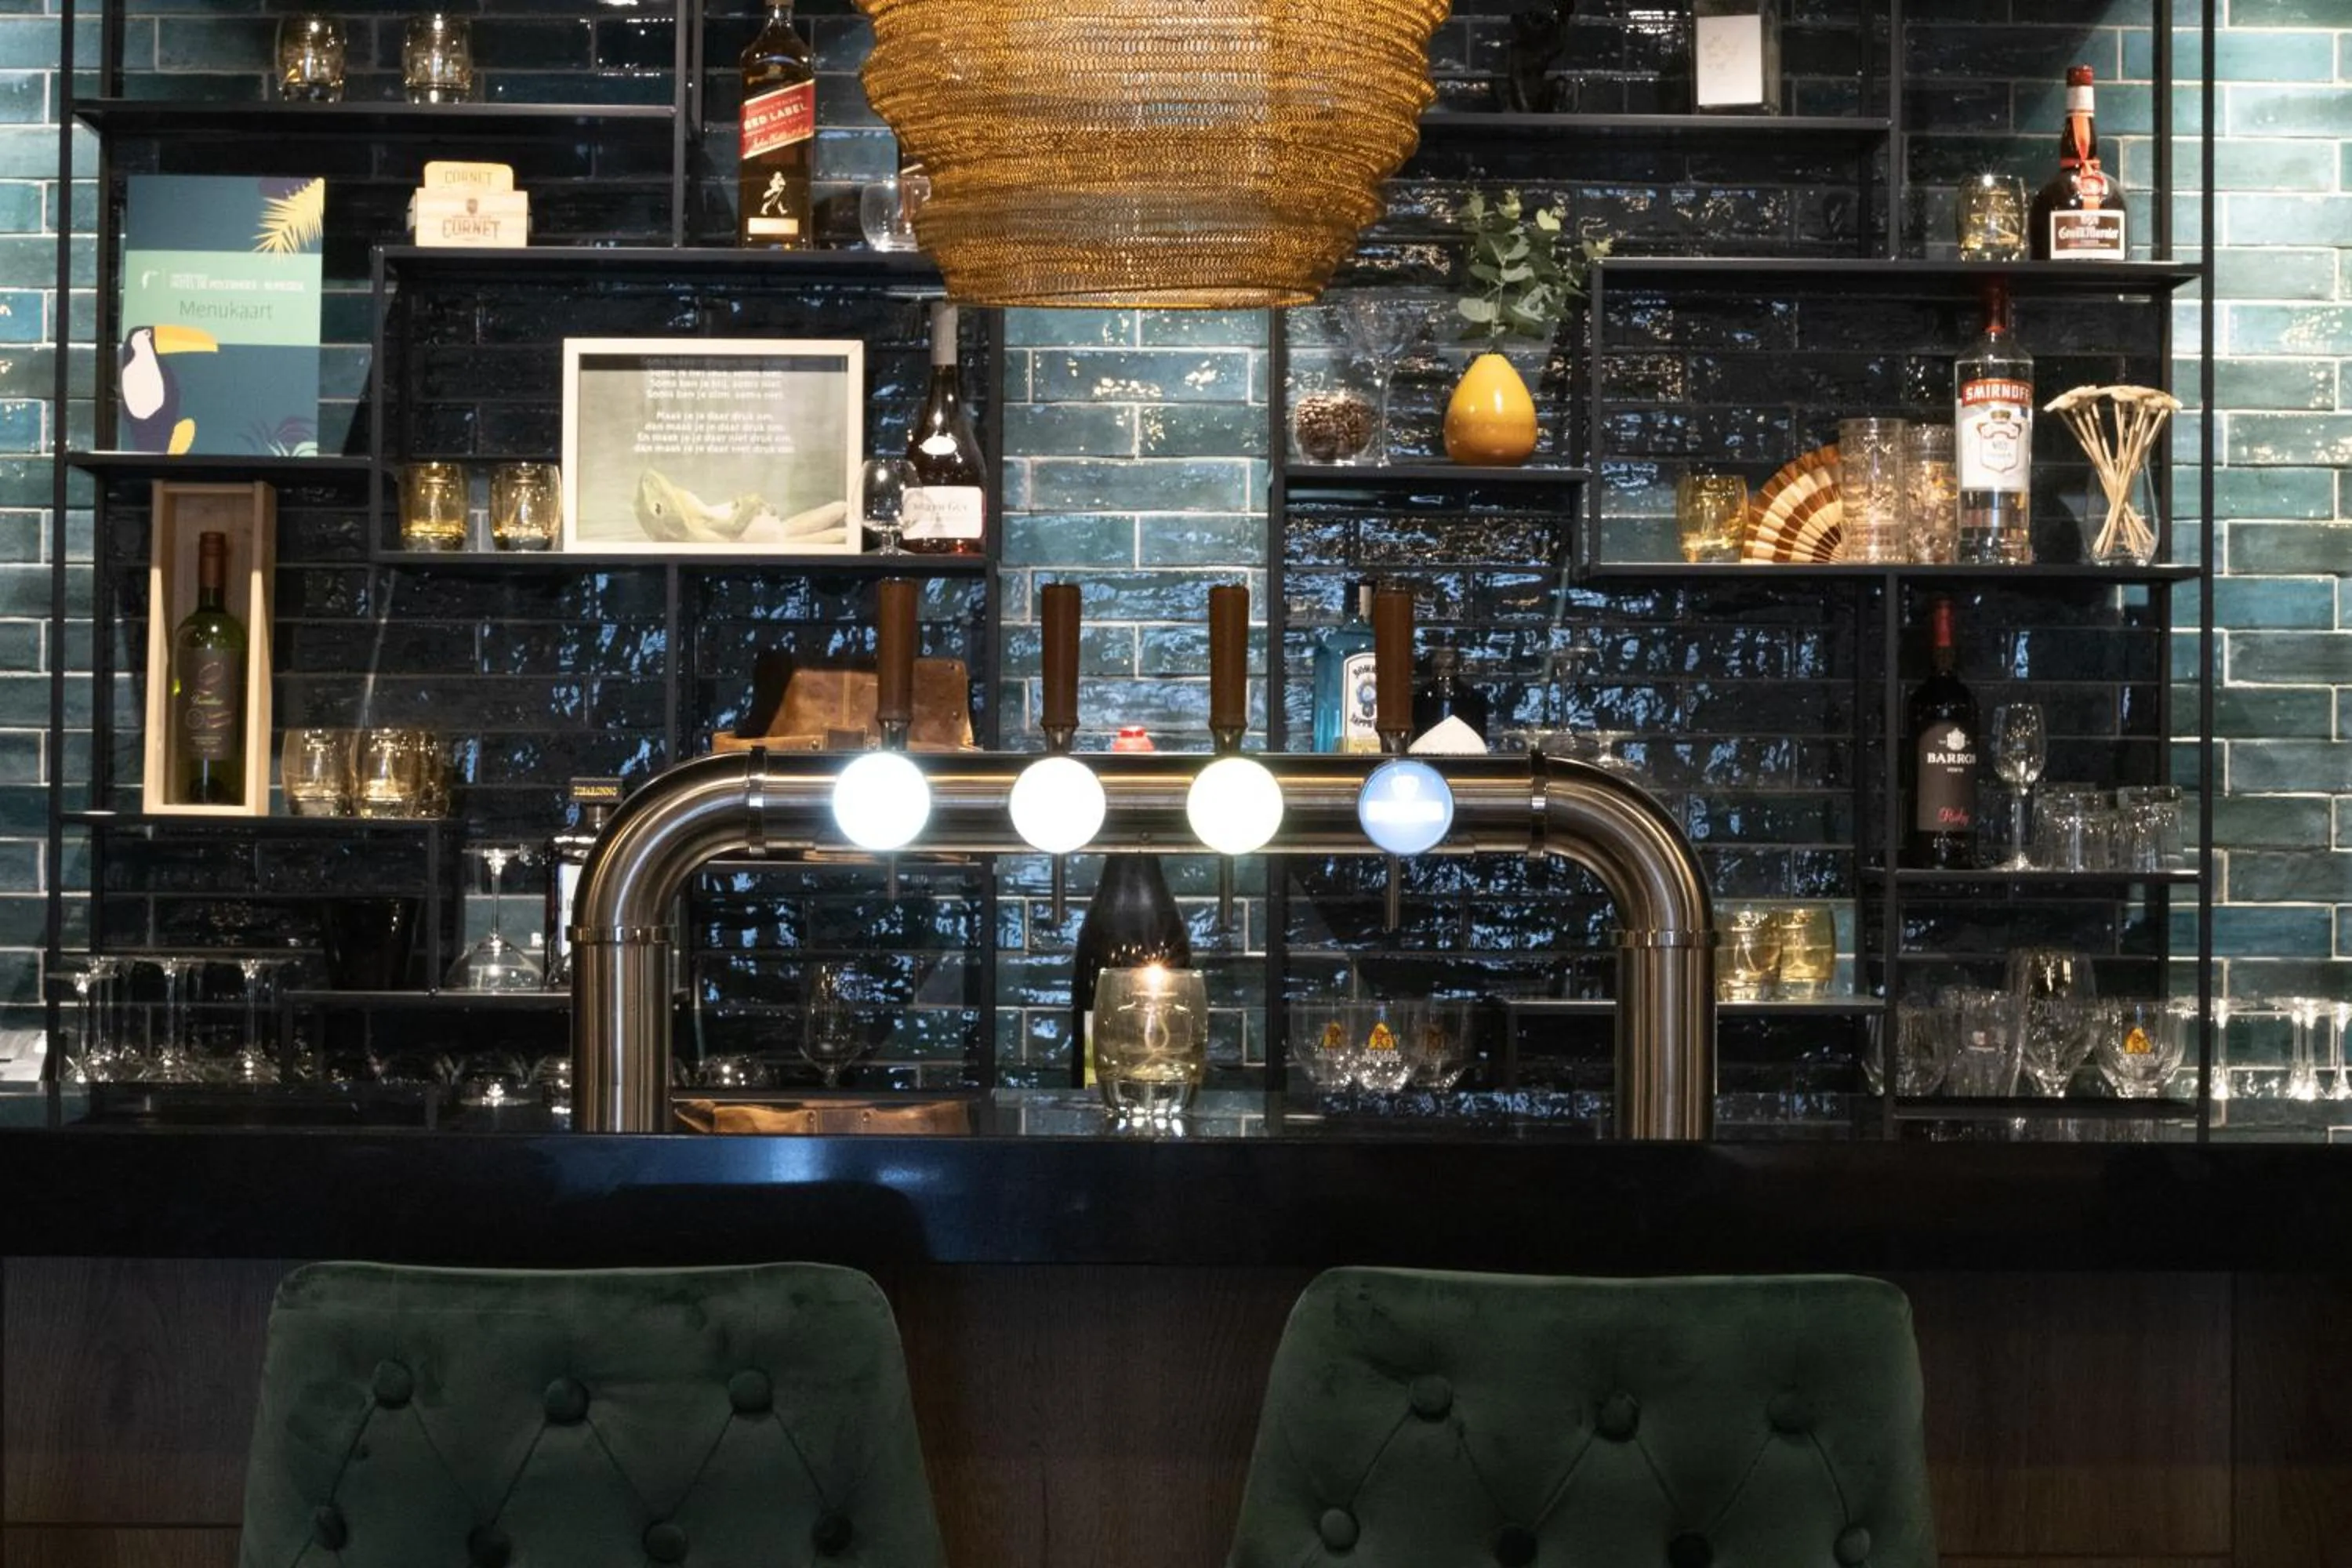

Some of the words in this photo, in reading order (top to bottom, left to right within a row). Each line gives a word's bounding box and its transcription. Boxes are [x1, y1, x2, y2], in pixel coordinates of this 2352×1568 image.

[744, 115, 768, 132] RED
[769, 103, 809, 122] LABEL
[445, 169, 492, 186] CORNET
[442, 219, 501, 240] CORNET
[180, 300, 274, 320] Menukaart
